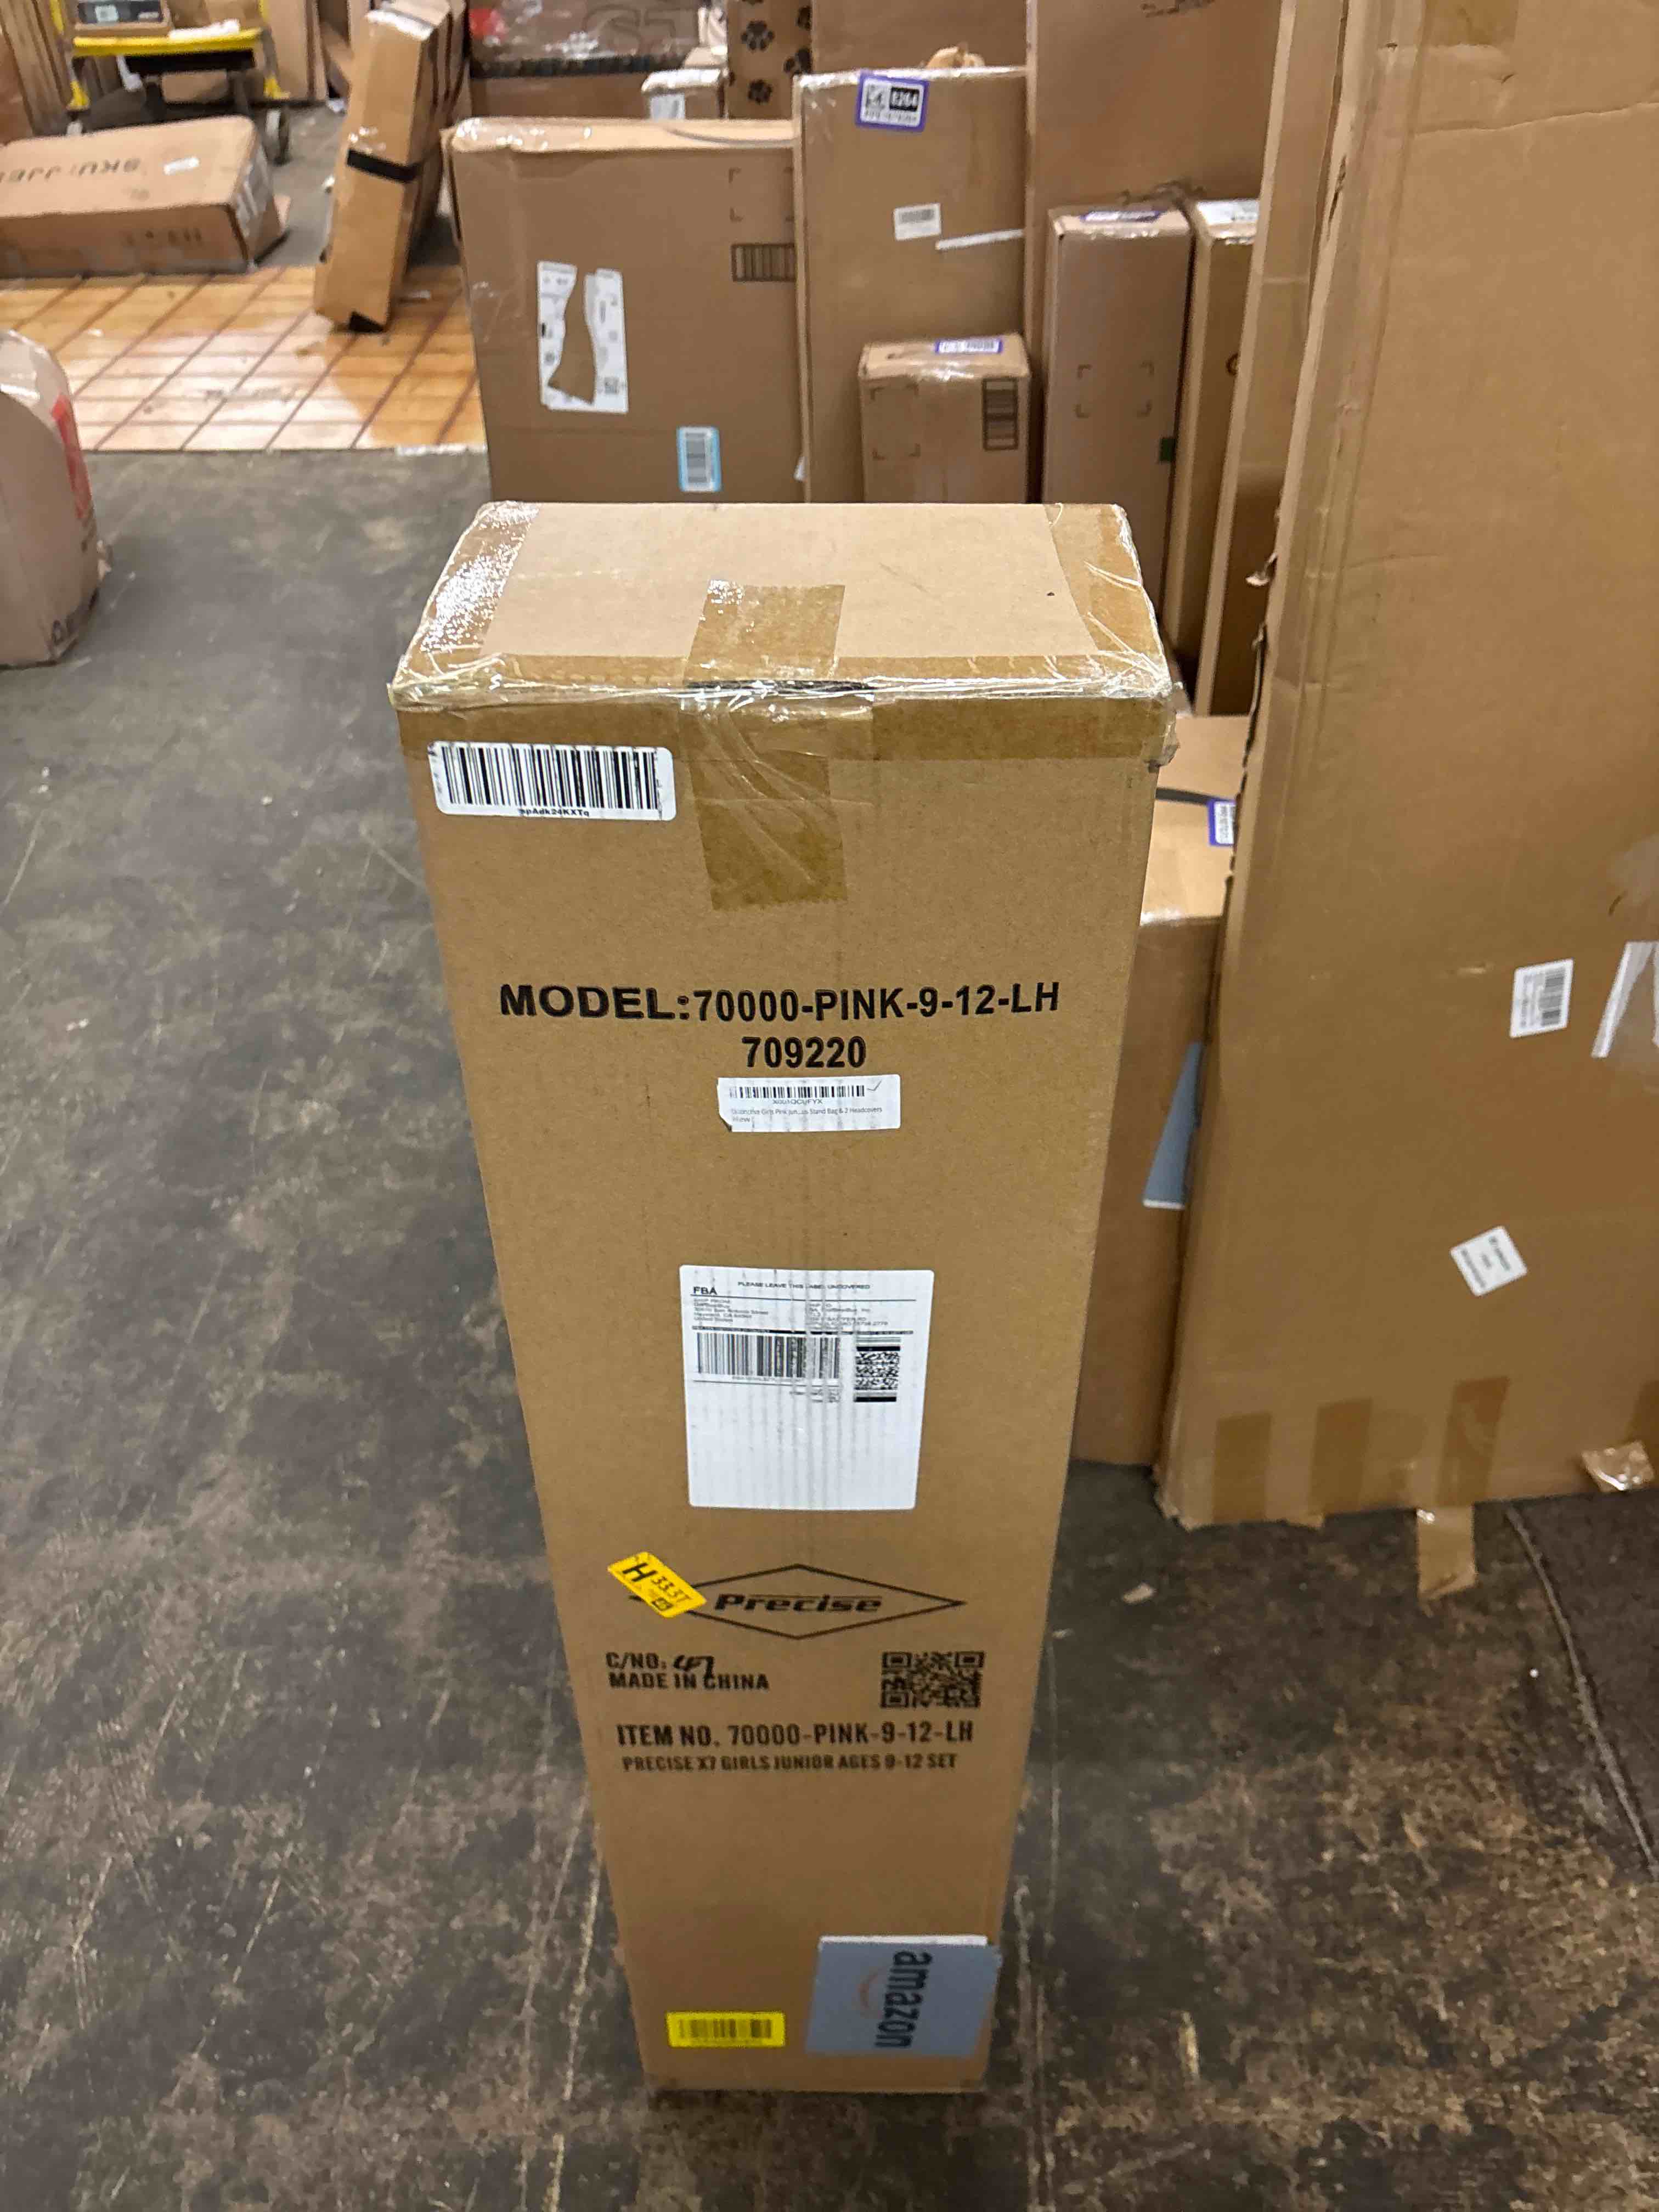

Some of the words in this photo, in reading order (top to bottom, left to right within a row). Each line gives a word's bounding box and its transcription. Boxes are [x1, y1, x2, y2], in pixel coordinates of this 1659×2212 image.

[742, 1036, 866, 1068] 709220
[693, 1286, 718, 1295] FBA
[714, 1594, 883, 1612] Precise
[608, 1672, 668, 1689] MADE
[674, 1673, 697, 1689] IN
[703, 1673, 769, 1690] CHINA
[617, 1724, 673, 1746] ITEM
[679, 1724, 720, 1747] NO.
[728, 1720, 973, 1746] 70000-PINK-9-12-LH
[623, 1756, 693, 1771] PRECISE
[721, 1756, 770, 1770] GIRLS
[838, 1754, 881, 1770] AGES
[927, 1753, 957, 1769] SET
[875, 1951, 933, 2048] amazon
